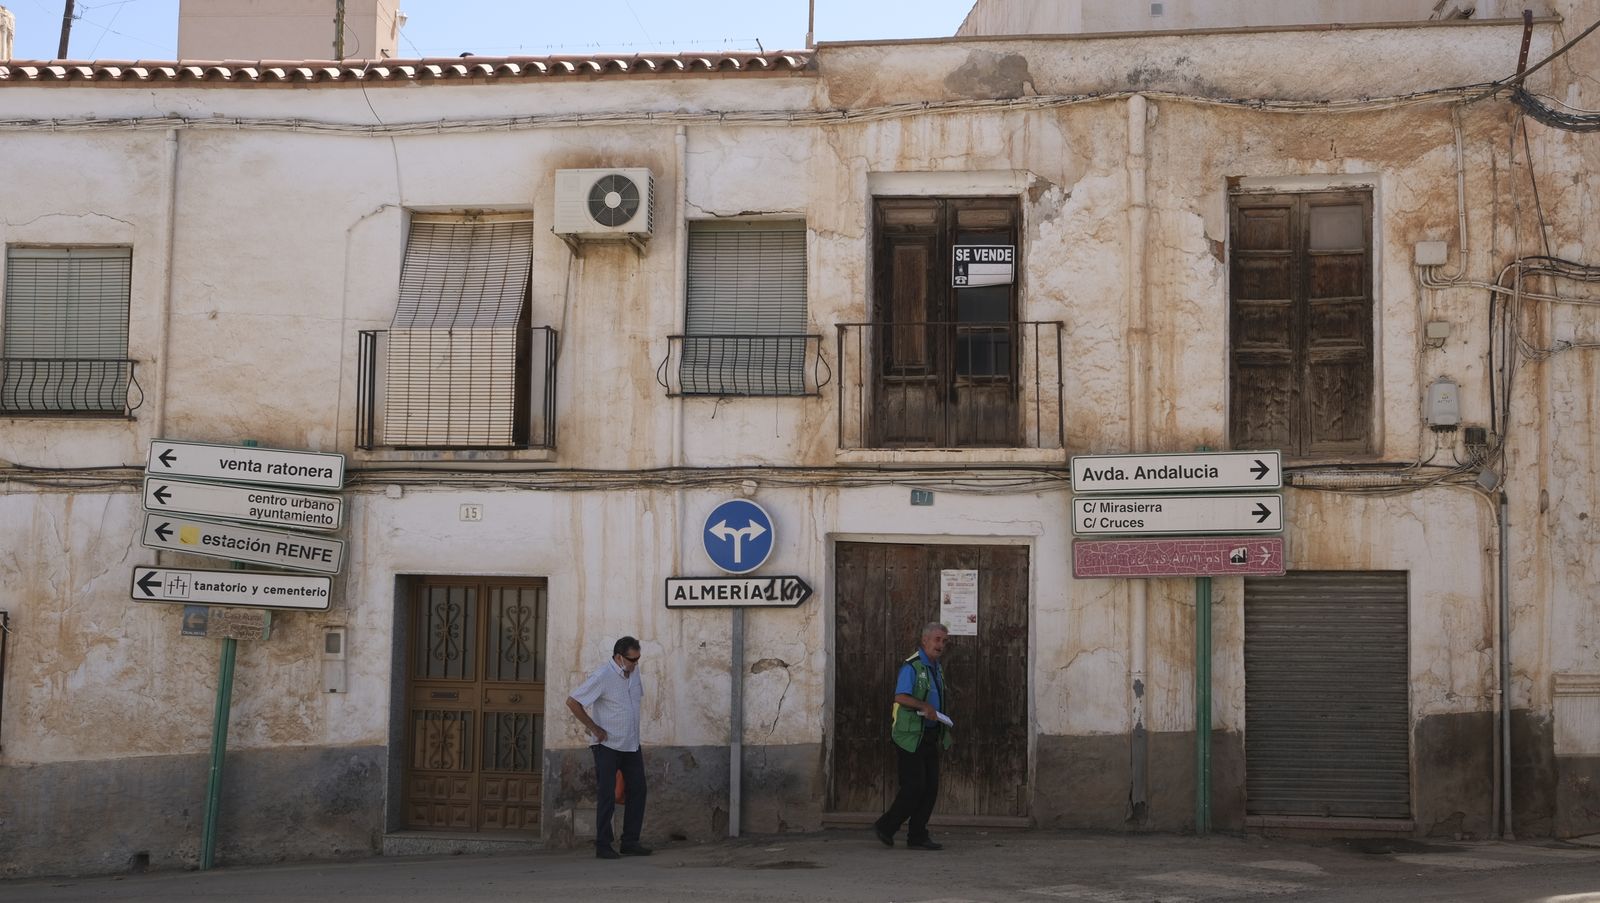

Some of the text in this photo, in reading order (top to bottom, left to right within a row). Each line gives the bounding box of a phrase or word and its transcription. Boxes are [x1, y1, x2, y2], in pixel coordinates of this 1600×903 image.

[956, 249, 1012, 261] SE VENDE
[219, 459, 333, 478] venta ratonera
[1082, 464, 1219, 481] Avda. Andalucia
[248, 494, 335, 511] centro urbano
[916, 492, 928, 503] 17
[249, 507, 333, 525] ayuntamiento
[465, 507, 477, 518] 15
[1083, 502, 1163, 513] C/ Mirasierra
[1083, 517, 1144, 528] C/ Cruces
[202, 534, 333, 563] estación RENFE
[194, 580, 327, 597] tanatorio y cementerio
[674, 582, 763, 600] ALMERÍA
